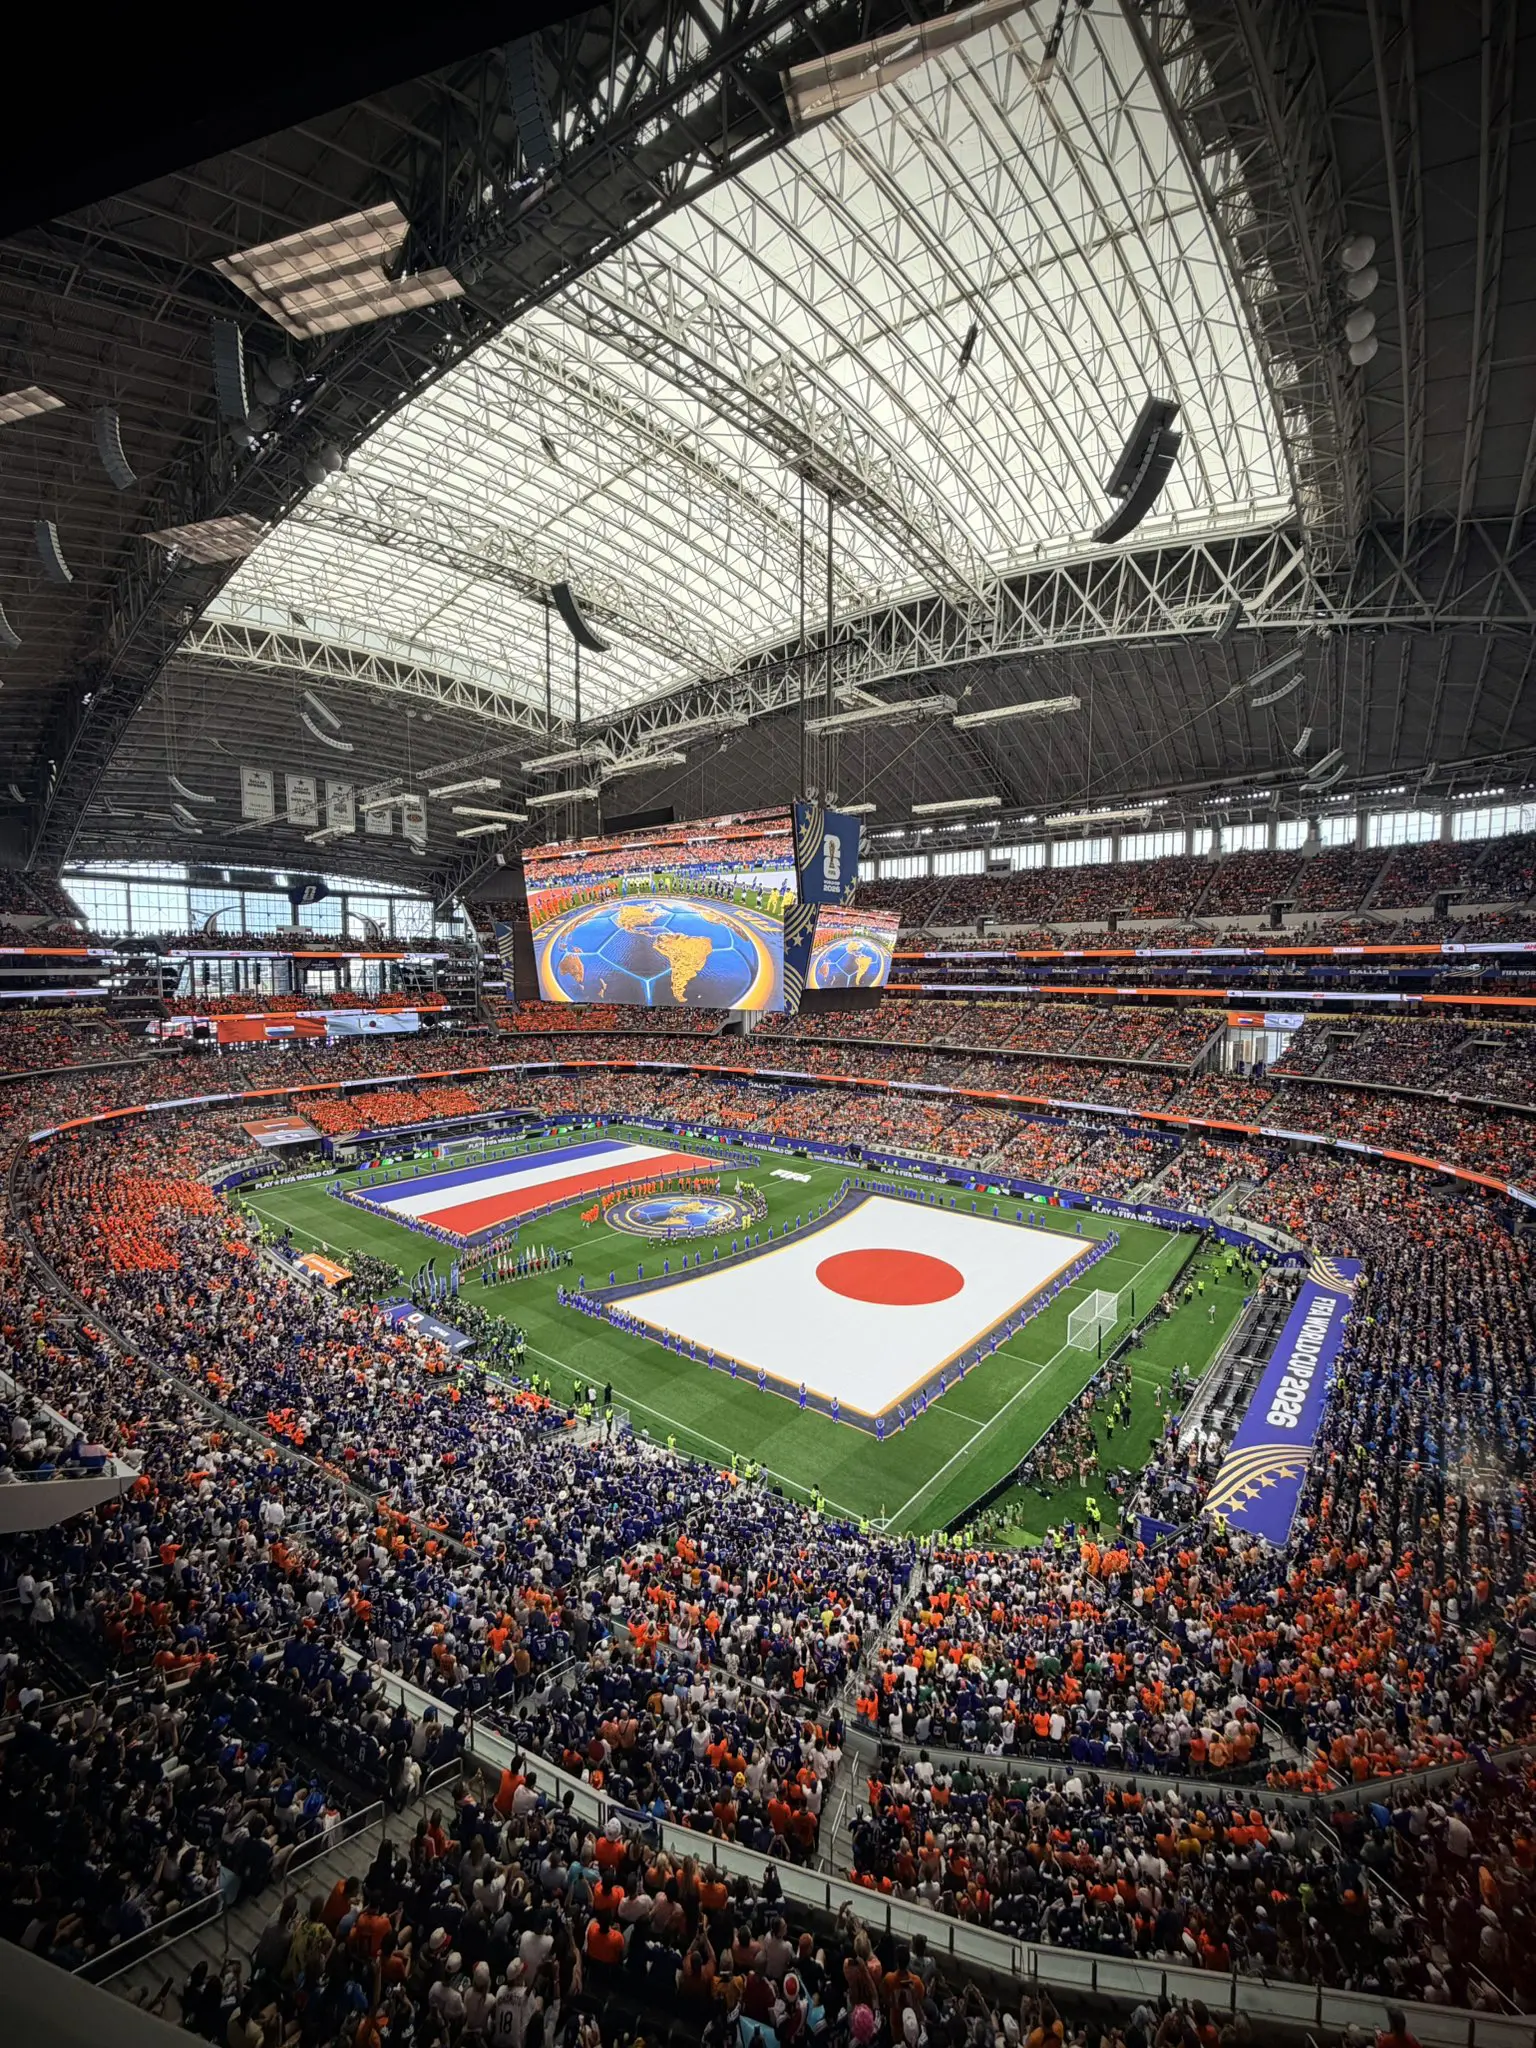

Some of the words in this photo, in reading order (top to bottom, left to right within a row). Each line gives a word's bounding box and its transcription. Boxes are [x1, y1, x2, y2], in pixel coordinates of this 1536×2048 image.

[823, 885, 841, 893] 2026
[748, 1082, 780, 1090] DALLAS
[1068, 1120, 1116, 1132] DALLA
[757, 1143, 768, 1151] FIFA
[767, 1146, 784, 1154] WORLD
[254, 1181, 274, 1190] PLAY
[280, 1176, 297, 1184] FIFA
[296, 1171, 322, 1181] WORLD
[321, 1168, 337, 1176] CUP
[769, 1168, 812, 1183] FIFA
[880, 1166, 895, 1174] PLAY
[899, 1170, 913, 1178] FIFA
[912, 1172, 935, 1182] WORLD
[934, 1176, 949, 1184] CUP
[1092, 1205, 1112, 1216] PLAY
[1118, 1211, 1137, 1221] FIFA
[1307, 1296, 1337, 1317] FIFA
[1295, 1316, 1331, 1355] WORLD
[1286, 1352, 1319, 1379] CUP
[1266, 1375, 1310, 1428] 2026
[776, 1755, 786, 1768] 10
[1481, 1748, 1492, 1764] 8
[500, 2010, 513, 2035] 18
